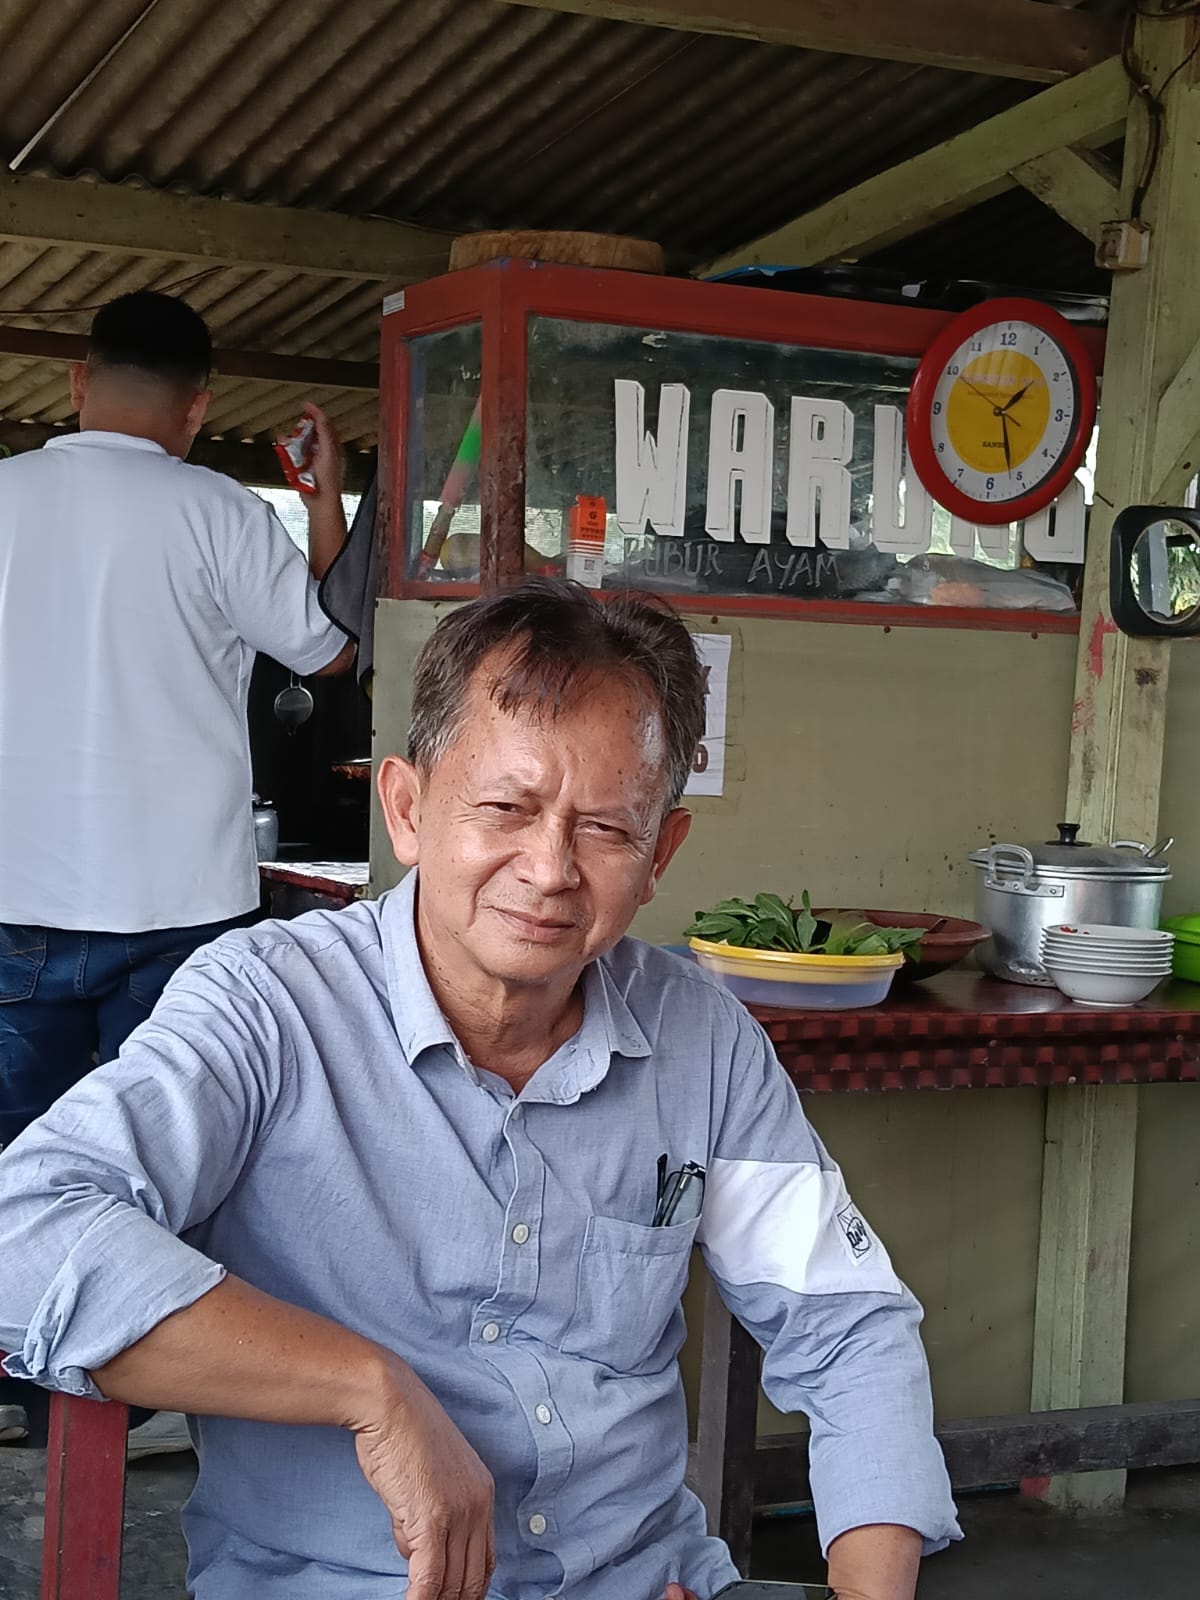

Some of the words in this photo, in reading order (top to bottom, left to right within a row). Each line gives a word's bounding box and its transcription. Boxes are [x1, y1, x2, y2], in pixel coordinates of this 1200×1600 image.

[1000, 332, 1017, 346] 12
[1034, 346, 1039, 356] 1
[947, 366, 959, 376] 10
[1053, 372, 1060, 382] 2
[933, 402, 942, 415] 9
[1055, 409, 1064, 422] 3
[938, 442, 945, 453] 8
[1042, 448, 1049, 458] 4
[957, 468, 965, 478] 7
[1016, 471, 1023, 481] 5
[986, 477, 995, 490] 6
[747, 548, 844, 590] AYAM
